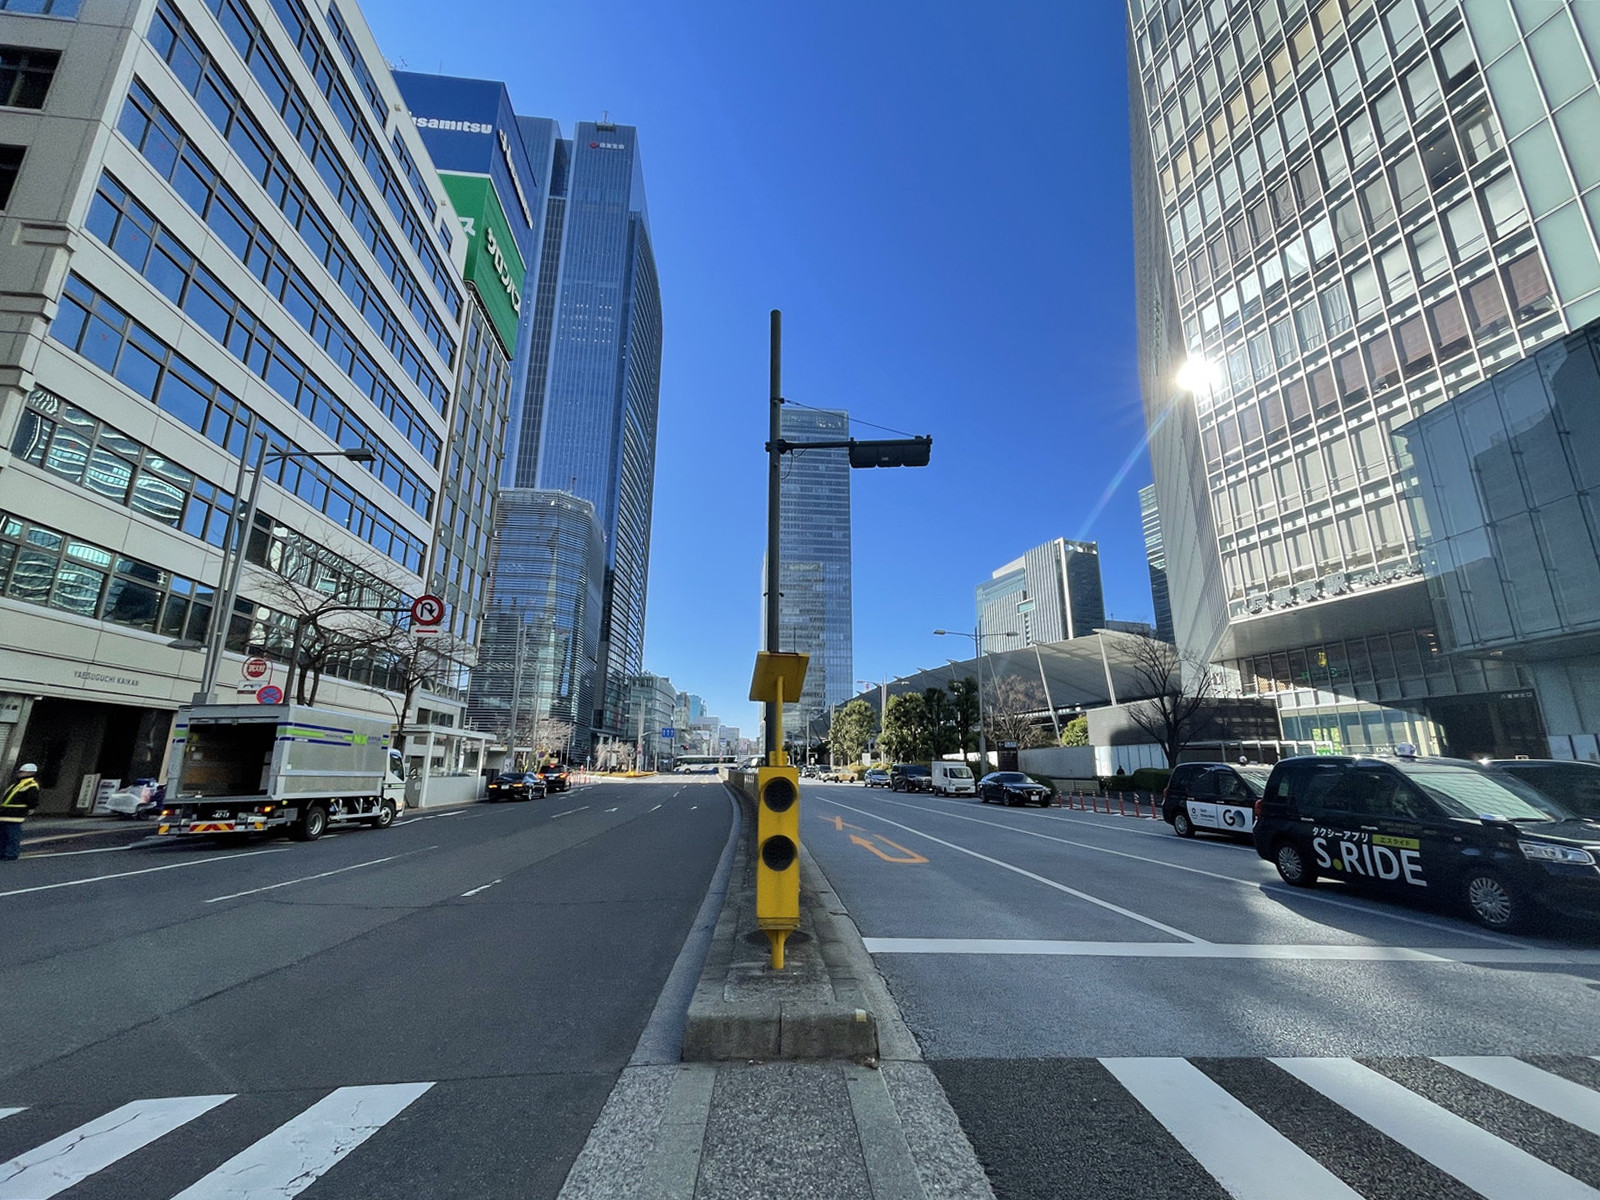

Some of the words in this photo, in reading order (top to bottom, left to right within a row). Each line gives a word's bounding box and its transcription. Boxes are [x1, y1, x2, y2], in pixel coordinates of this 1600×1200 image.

[408, 112, 493, 134] isamitsu
[1312, 826, 1369, 843] タクシーアプリ
